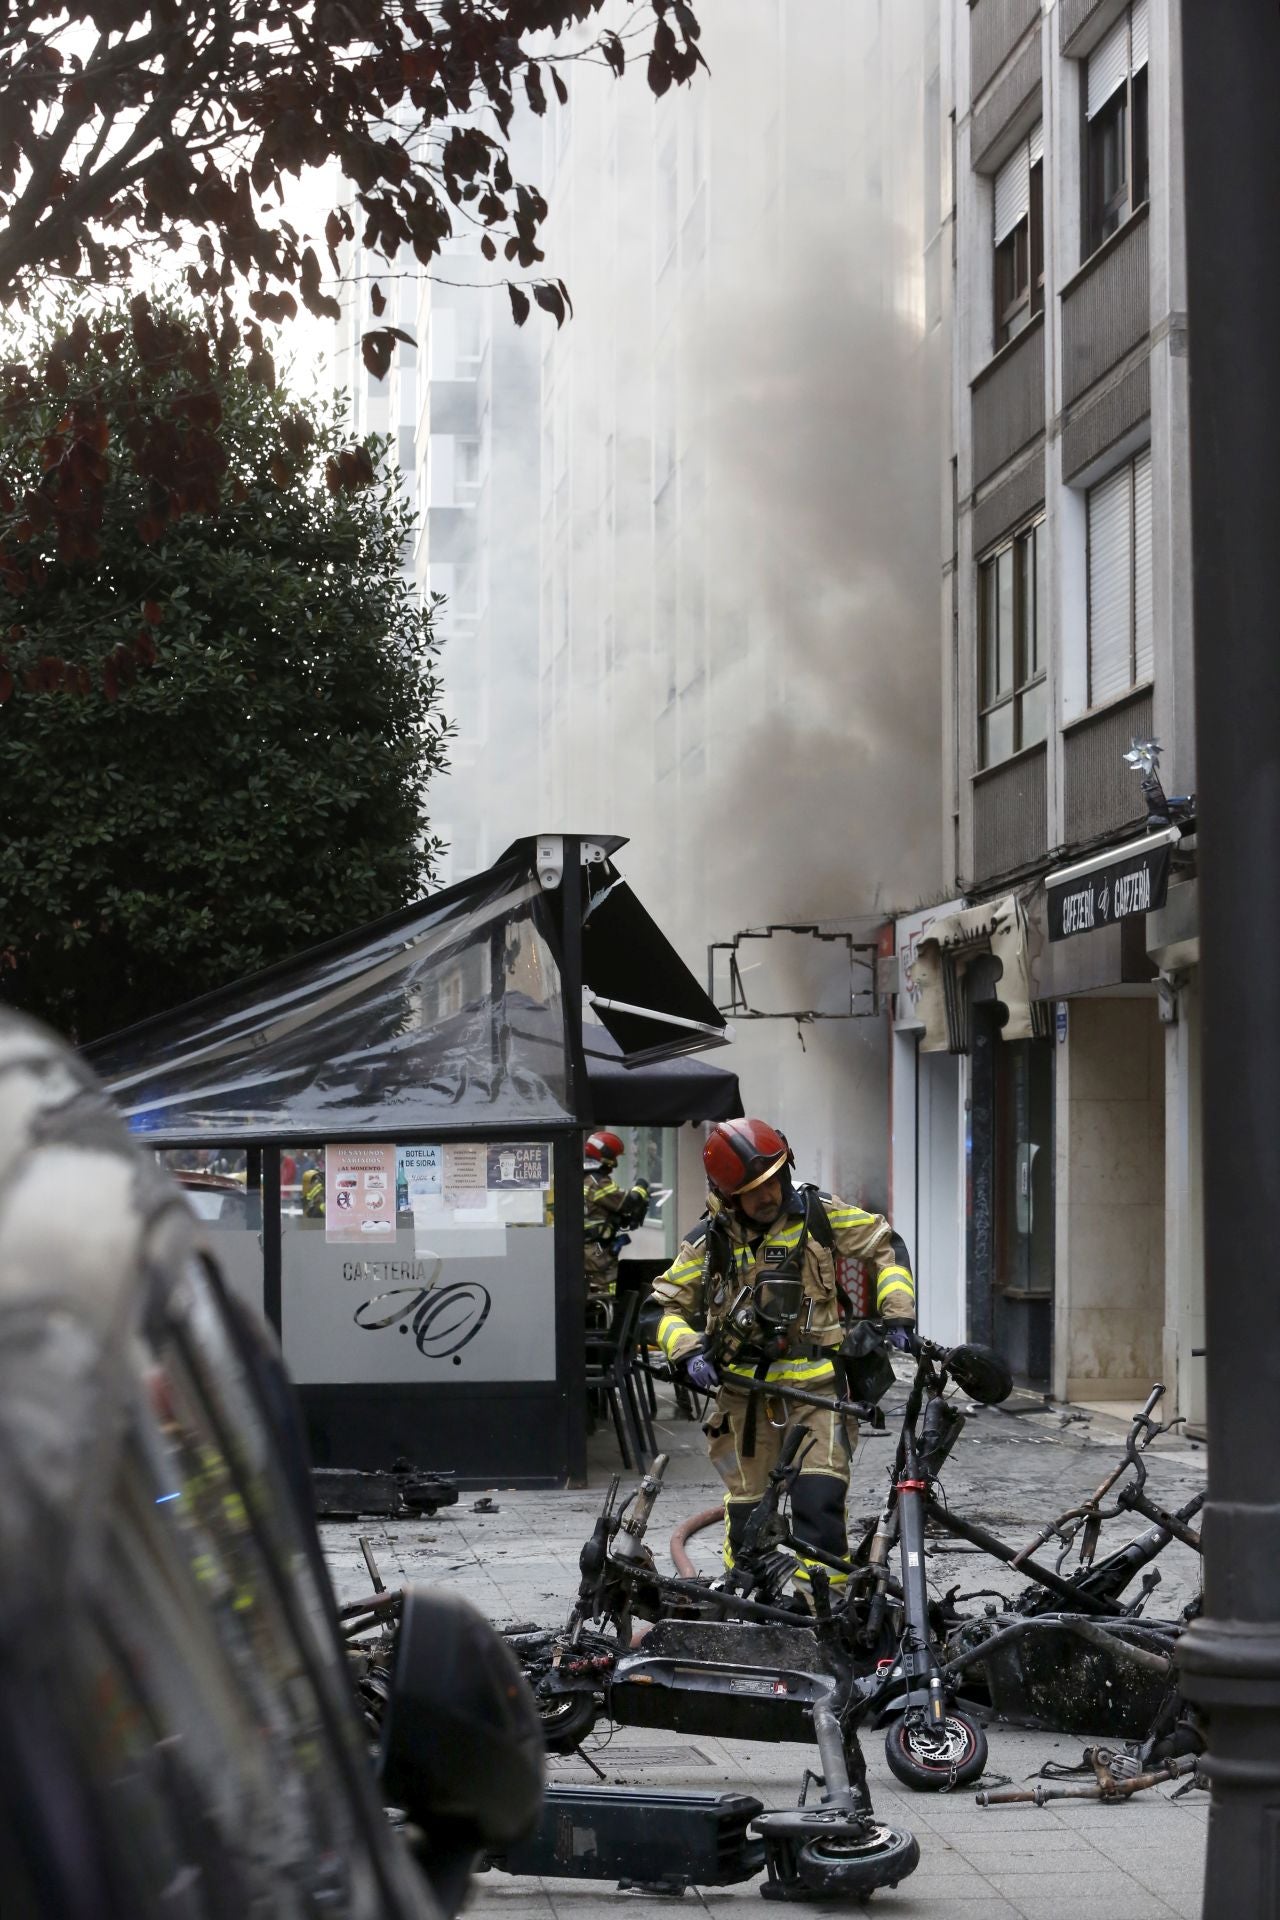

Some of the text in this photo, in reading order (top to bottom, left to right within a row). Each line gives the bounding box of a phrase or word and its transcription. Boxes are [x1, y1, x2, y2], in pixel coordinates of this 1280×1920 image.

[516, 1147, 541, 1161] CAFÉ
[523, 1162, 541, 1171] PARA
[515, 1170, 542, 1179] LLEVAR
